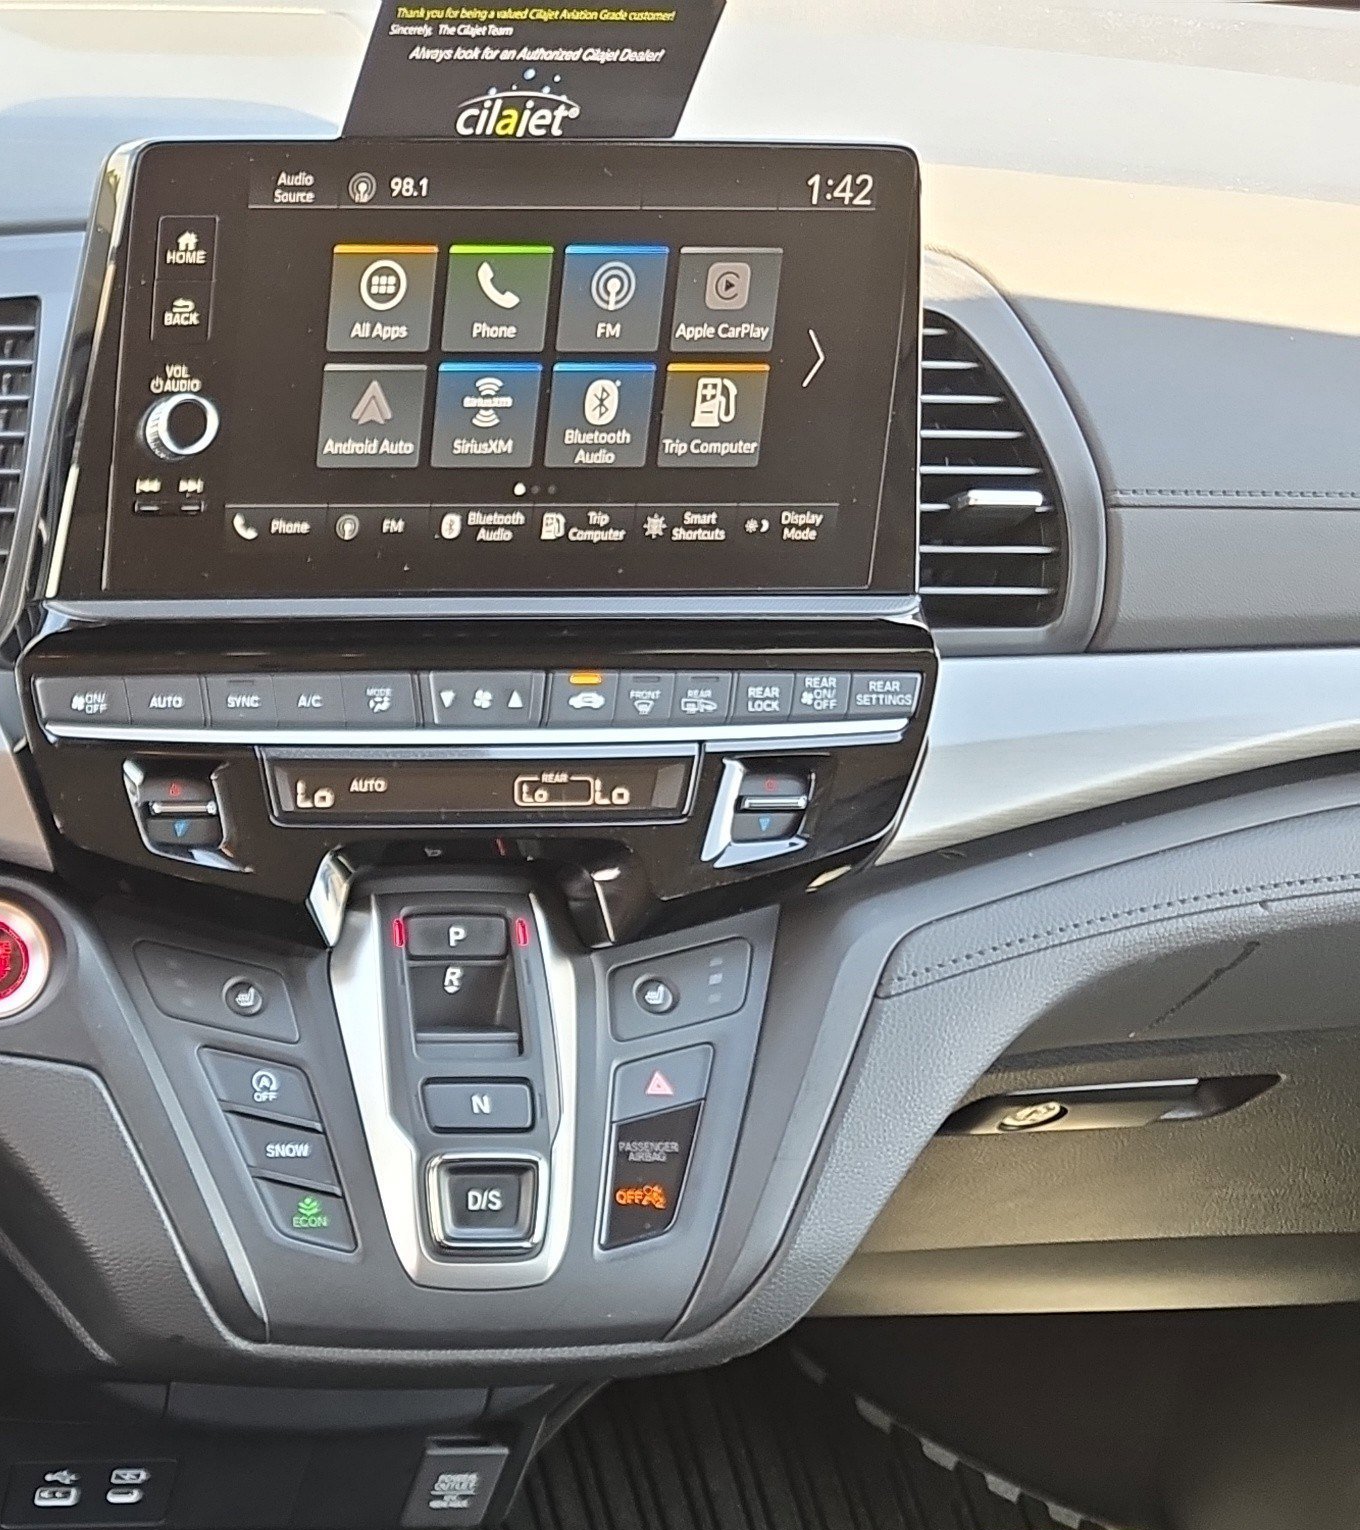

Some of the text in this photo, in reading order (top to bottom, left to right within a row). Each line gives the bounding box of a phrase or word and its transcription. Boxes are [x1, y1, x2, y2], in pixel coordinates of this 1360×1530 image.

[397, 8, 425, 18] Thank
[425, 9, 444, 20] you
[445, 8, 460, 18] for
[460, 8, 488, 20] being
[497, 8, 528, 19] valued
[529, 9, 559, 21] Cilajet
[560, 9, 598, 20] Aviation
[599, 10, 627, 20] Grade
[628, 11, 676, 20] customer!
[438, 24, 456, 35] The
[457, 25, 487, 37] Cilajet
[488, 25, 513, 35] Team
[409, 46, 665, 63] Always look for an Authorized Cilajet Dealer!
[277, 171, 314, 187] Audio
[390, 176, 430, 198] 98.1
[806, 174, 874, 206] 1:42
[274, 189, 315, 203] Source
[166, 250, 207, 265] HOME
[164, 312, 200, 327] BACK
[351, 323, 408, 340] All Apps
[472, 322, 517, 339] Phone
[596, 323, 621, 338] FM
[676, 322, 770, 341] Apple CarPlay
[165, 364, 190, 379] VOL
[164, 379, 201, 392] AUDIO
[564, 429, 631, 445] Bluetooth
[323, 438, 415, 456] Android Auto
[452, 437, 514, 455] SiriusXM
[662, 438, 758, 457] Trip Computer
[574, 448, 615, 465] Audio
[467, 510, 526, 526] Bluetooth
[587, 510, 610, 527] Trip
[683, 511, 717, 526] Smart
[781, 510, 823, 528] Display
[270, 518, 310, 534] Phone
[382, 518, 405, 534] FM
[671, 526, 726, 541] Shortcuts
[782, 526, 817, 541] Mode
[476, 527, 513, 542] Audio
[568, 526, 626, 542] Computer
[805, 676, 837, 689] REAR
[869, 680, 901, 693] REAR
[85, 692, 107, 704] ON/
[366, 688, 392, 698] MODE
[630, 690, 662, 700] FRONT
[687, 689, 713, 700] REAR
[748, 686, 780, 699] REAR
[813, 689, 837, 700] ON/
[856, 693, 912, 707] SETTINGS
[149, 694, 184, 709] AUTO
[226, 694, 261, 709] SYNC
[298, 693, 323, 708] A/C
[747, 699, 781, 713] LOCK
[813, 699, 838, 711] OFF
[85, 703, 108, 714] OFF
[349, 776, 389, 793] AUTO
[542, 773, 568, 784] REAR
[296, 779, 335, 809] Lo
[448, 924, 468, 948] P
[444, 965, 464, 986] R
[253, 1091, 278, 1102] OFF
[471, 1093, 491, 1115] N
[266, 1143, 310, 1158] SNOW
[618, 1141, 679, 1153] PASSENGER
[628, 1152, 668, 1163] AIRBAG
[467, 1188, 503, 1212] D/S
[615, 1187, 644, 1205] OFF
[292, 1216, 329, 1228] ECON
